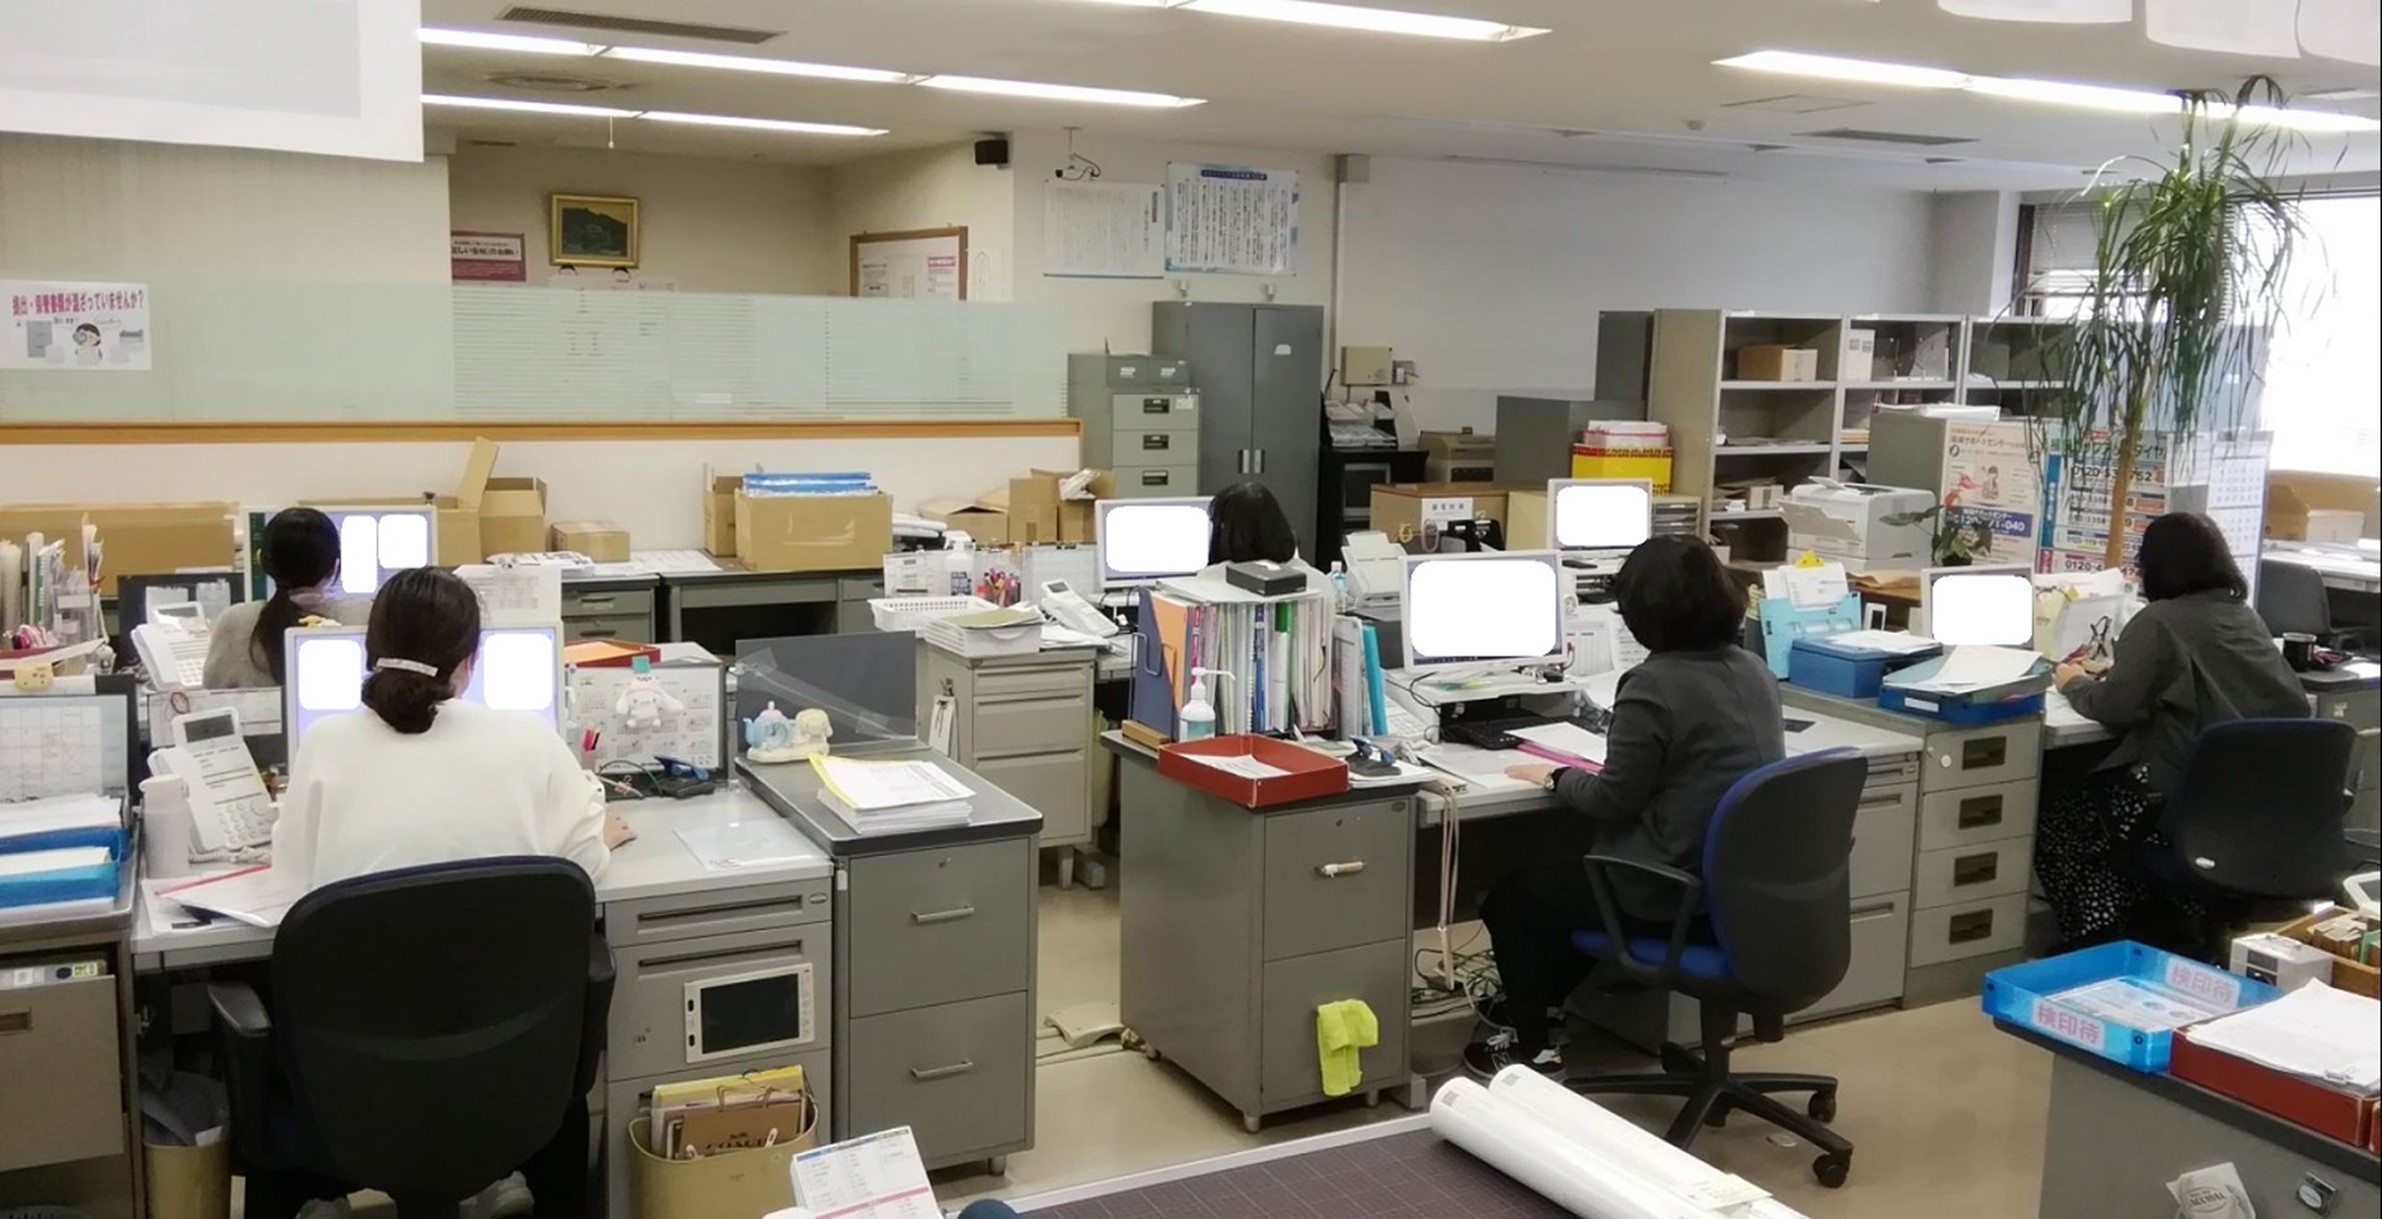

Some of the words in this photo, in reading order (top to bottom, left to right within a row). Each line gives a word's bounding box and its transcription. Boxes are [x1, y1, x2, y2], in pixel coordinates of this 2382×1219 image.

[2171, 963, 2235, 1004] 検印待
[2037, 1003, 2100, 1045] 検印待
